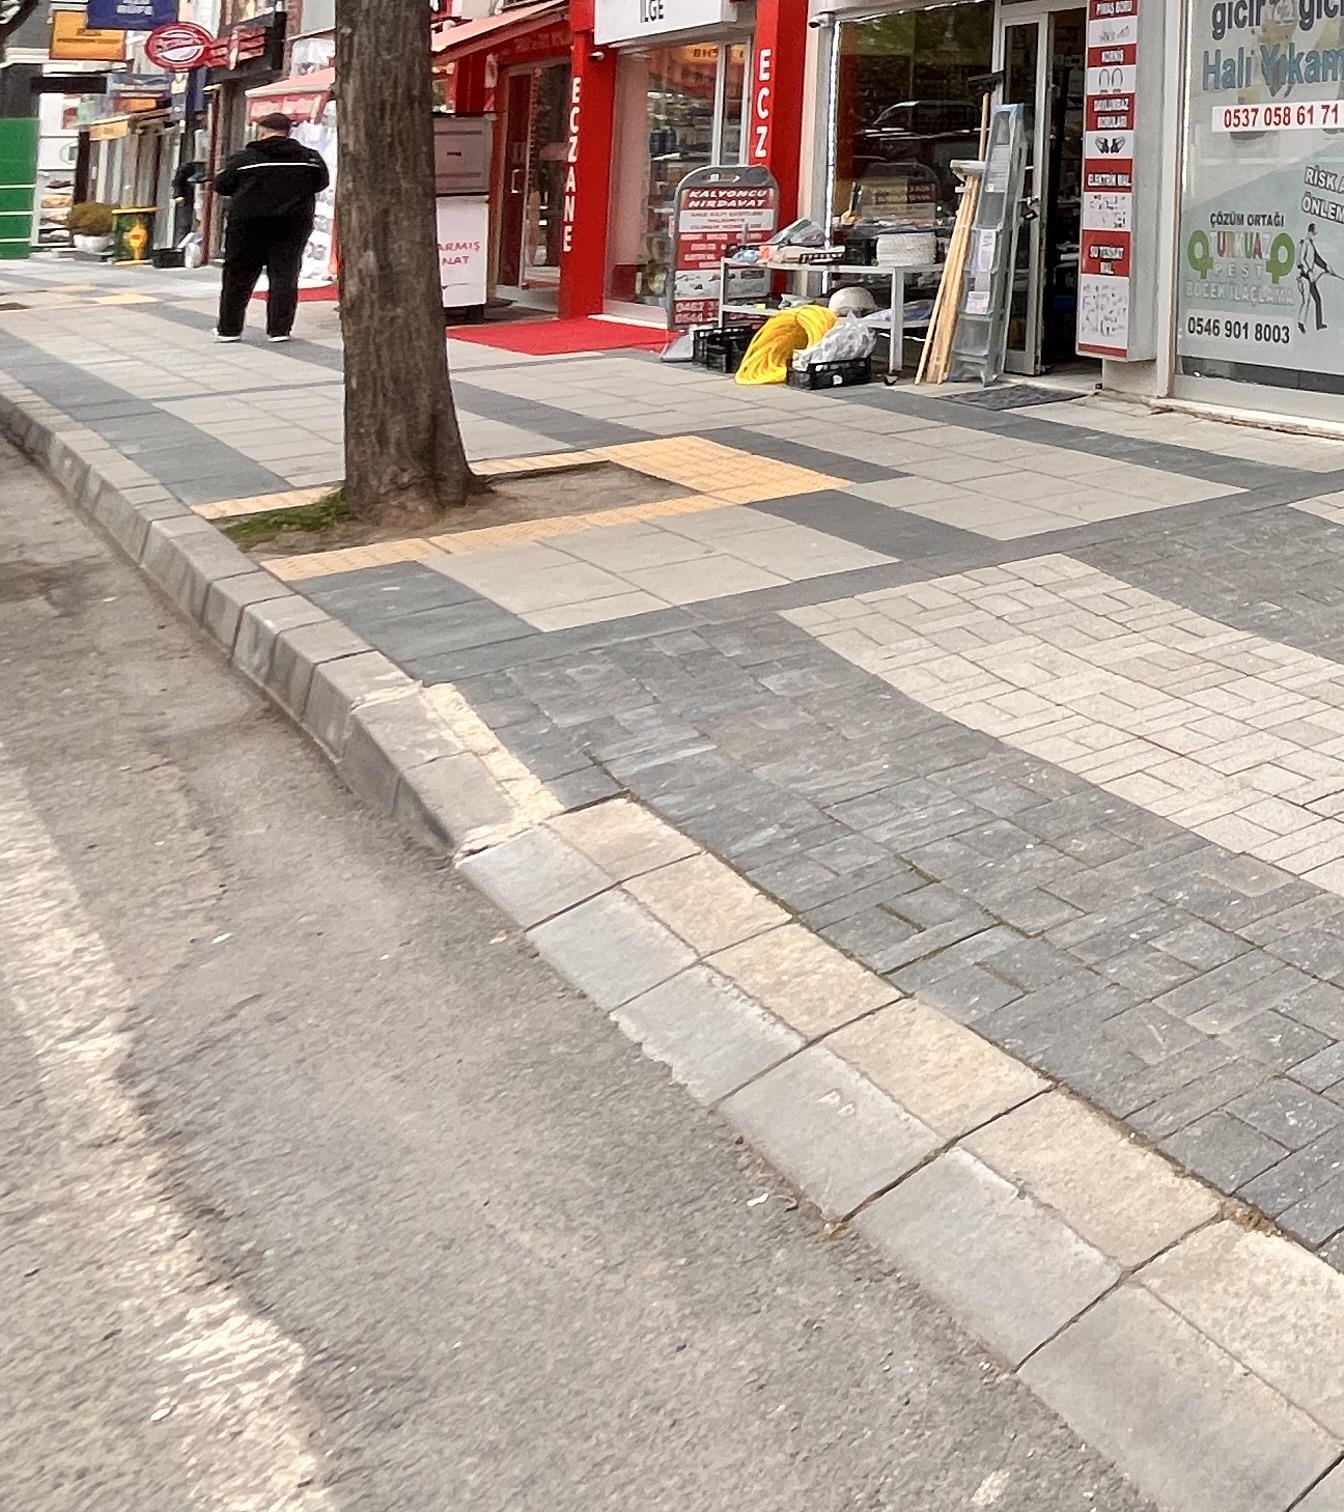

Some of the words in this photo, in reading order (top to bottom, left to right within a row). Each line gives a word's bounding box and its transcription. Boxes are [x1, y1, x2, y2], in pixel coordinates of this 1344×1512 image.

[1202, 46, 1252, 90] Halı
[754, 48, 772, 158] ECZ
[1223, 108, 1259, 129] 0537
[1264, 106, 1291, 126] 058
[1296, 104, 1314, 125] 61
[1321, 103, 1339, 124] 71
[562, 77, 582, 253] ECZANE
[1305, 165, 1337, 190] RİSK
[689, 189, 768, 199] KALYONCU
[1210, 211, 1245, 227] ÇÖZÜM
[1247, 211, 1285, 228] ORTAĞI
[1187, 316, 1221, 337] 0546
[1224, 320, 1249, 340] 901
[1254, 323, 1290, 344] 8003
